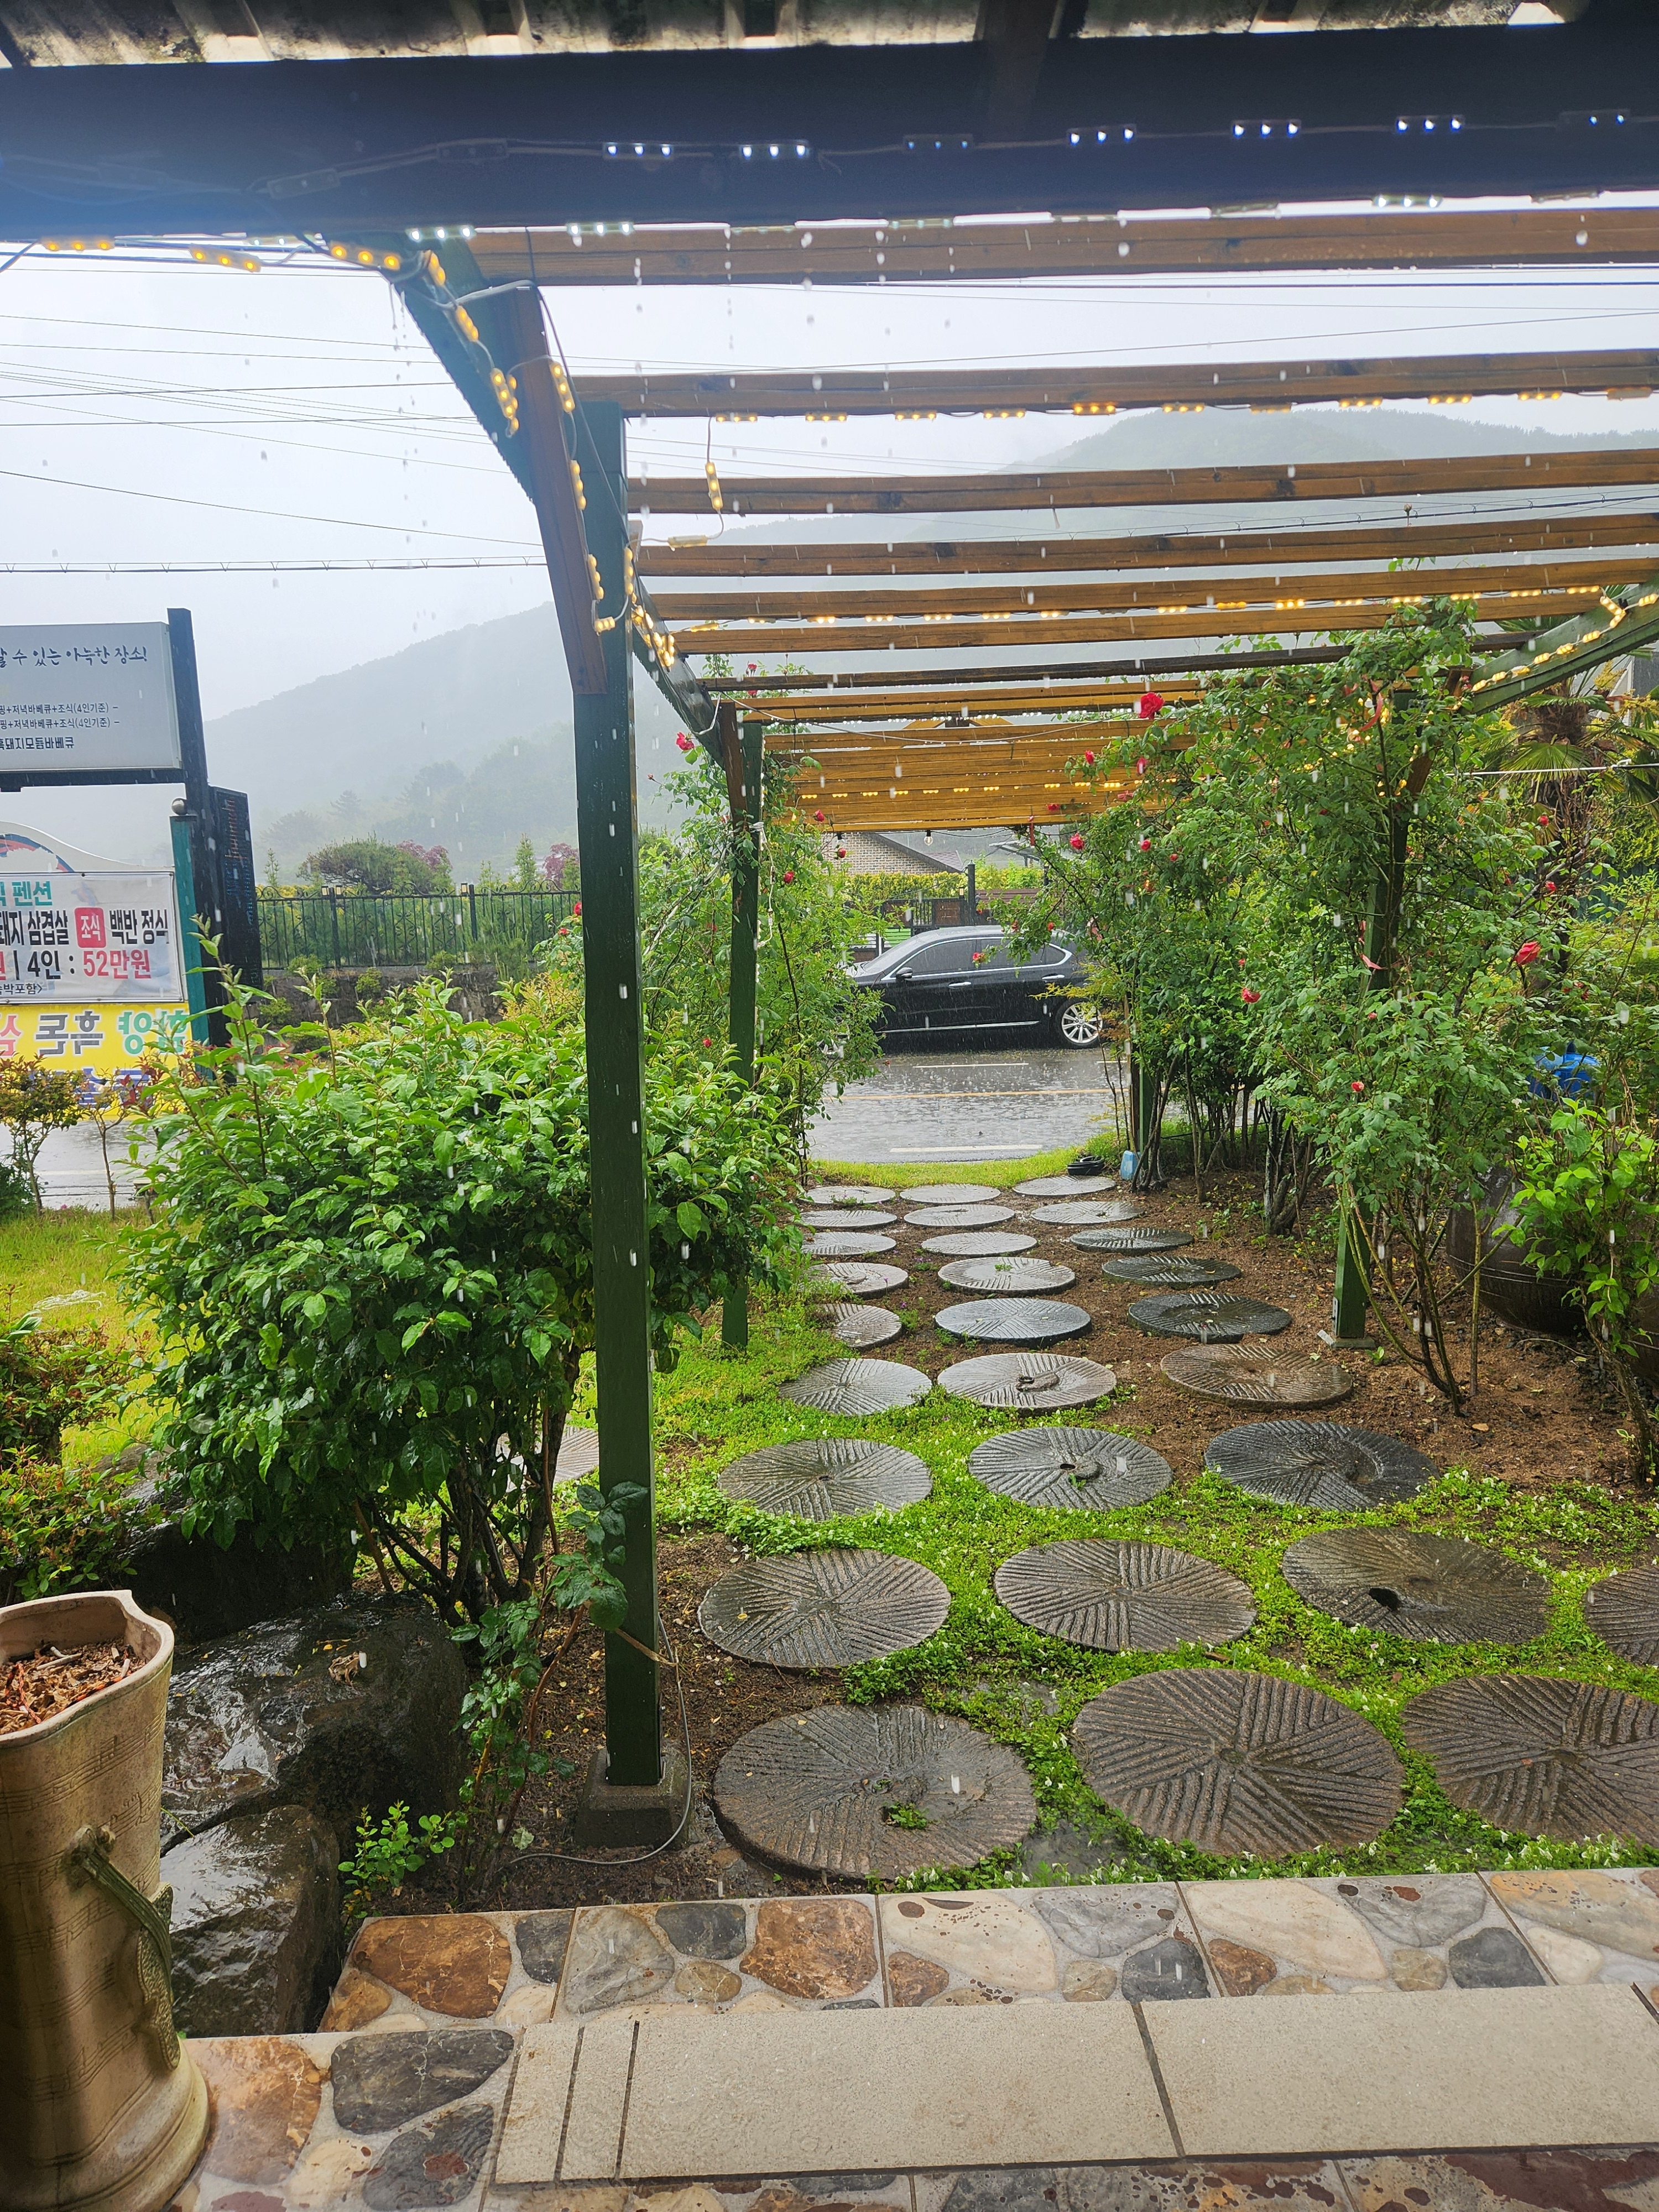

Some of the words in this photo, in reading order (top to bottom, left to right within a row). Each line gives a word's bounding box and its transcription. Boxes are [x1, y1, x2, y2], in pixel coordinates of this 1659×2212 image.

[12, 649, 28, 666] 수
[33, 646, 62, 666] 있는
[66, 645, 110, 666] 아늑한
[12, 881, 53, 906] 펜션
[28, 910, 70, 945] 삼겹살
[81, 915, 101, 941] 조식
[109, 909, 138, 945] 백반
[141, 909, 170, 945] 정식
[28, 950, 61, 980] 4인
[83, 949, 152, 979] 52만원
[0, 983, 43, 995] 박포함>
